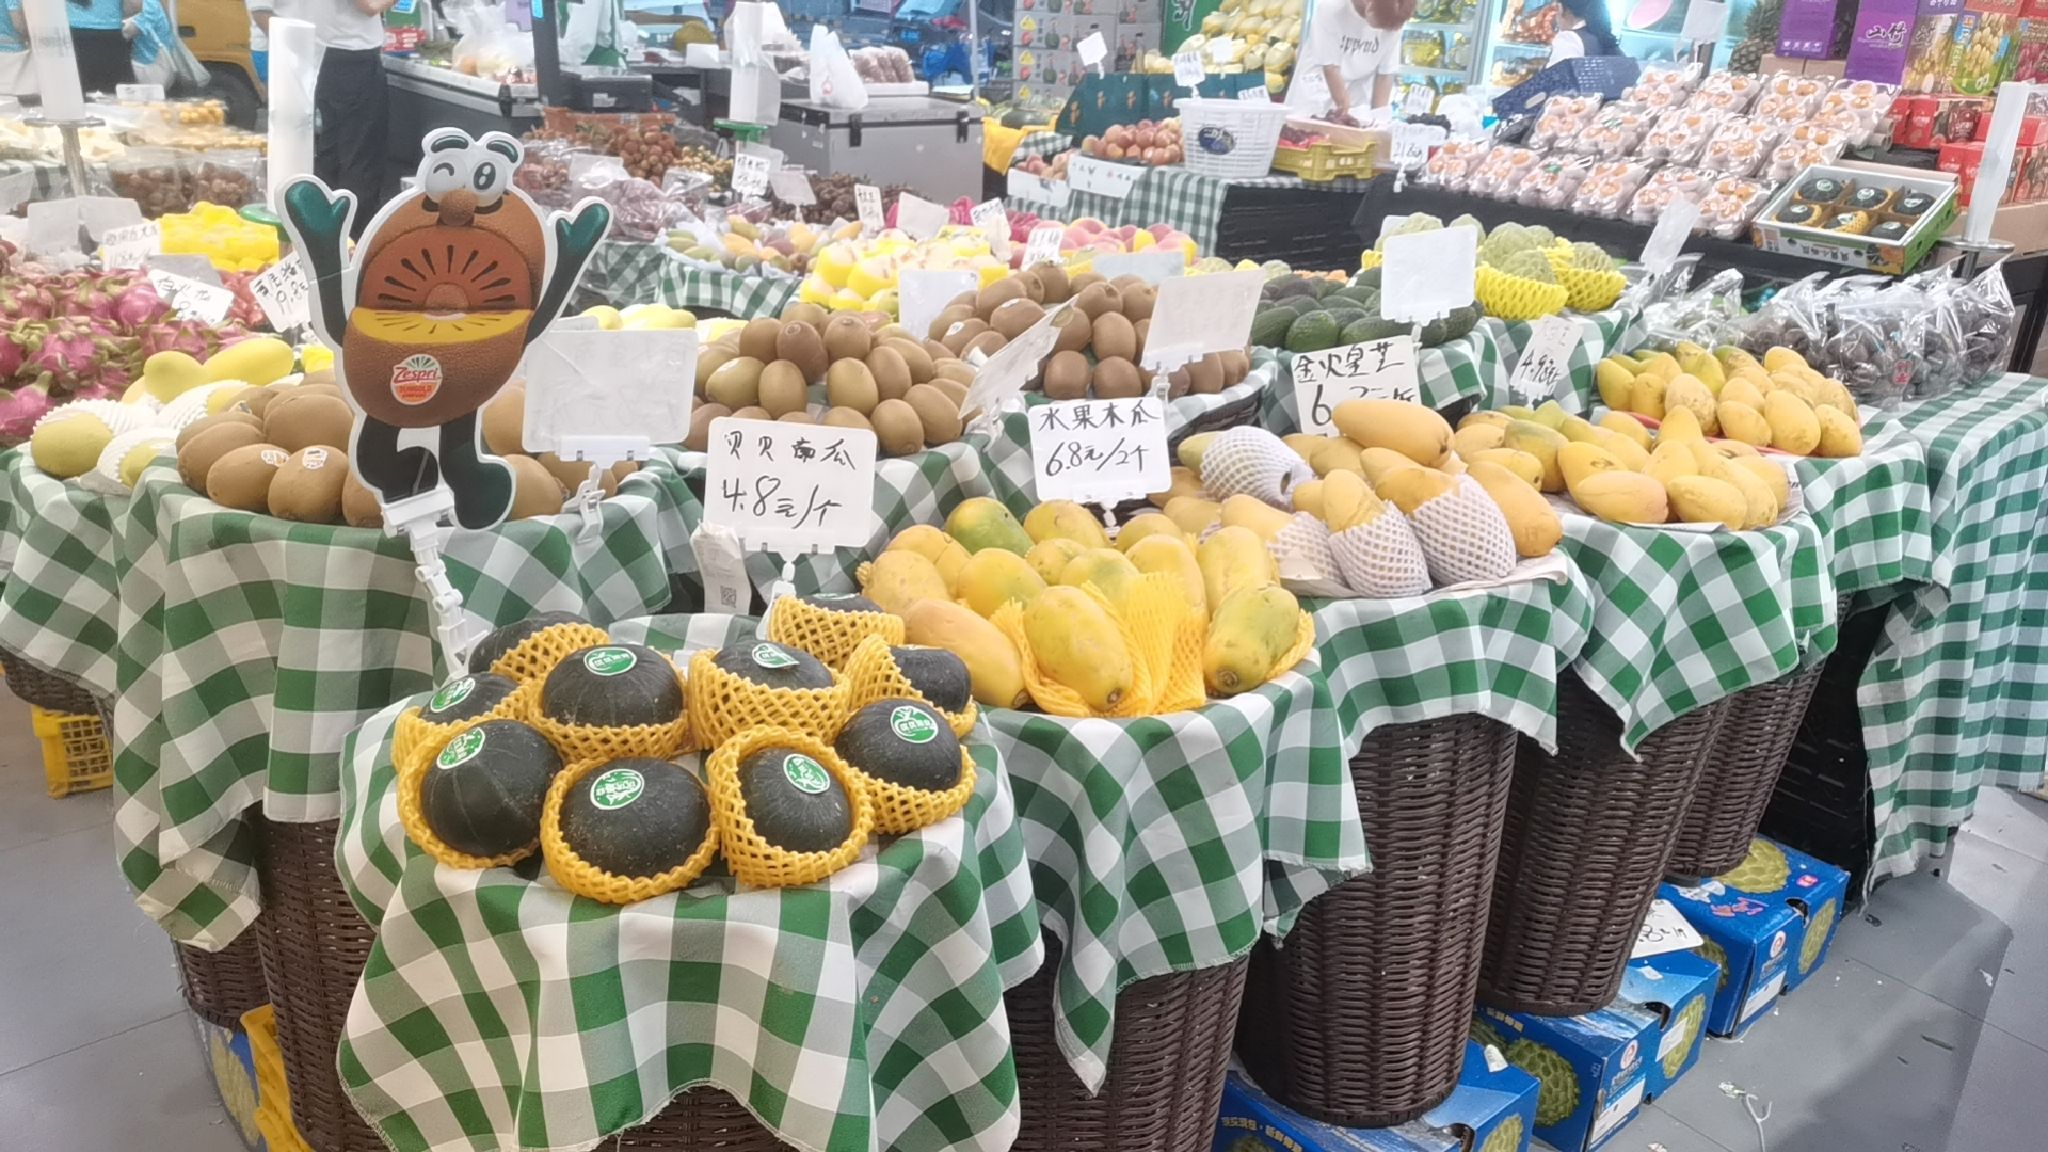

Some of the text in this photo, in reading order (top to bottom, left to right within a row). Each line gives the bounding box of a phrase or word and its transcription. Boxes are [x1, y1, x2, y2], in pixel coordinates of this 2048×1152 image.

[394, 366, 442, 384] Zespri
[1038, 399, 1162, 432] 水果木瓜
[724, 430, 856, 470] 贝贝南瓜
[1045, 436, 1150, 477] 6.8元/2个
[721, 475, 843, 529] 4.8元/个
